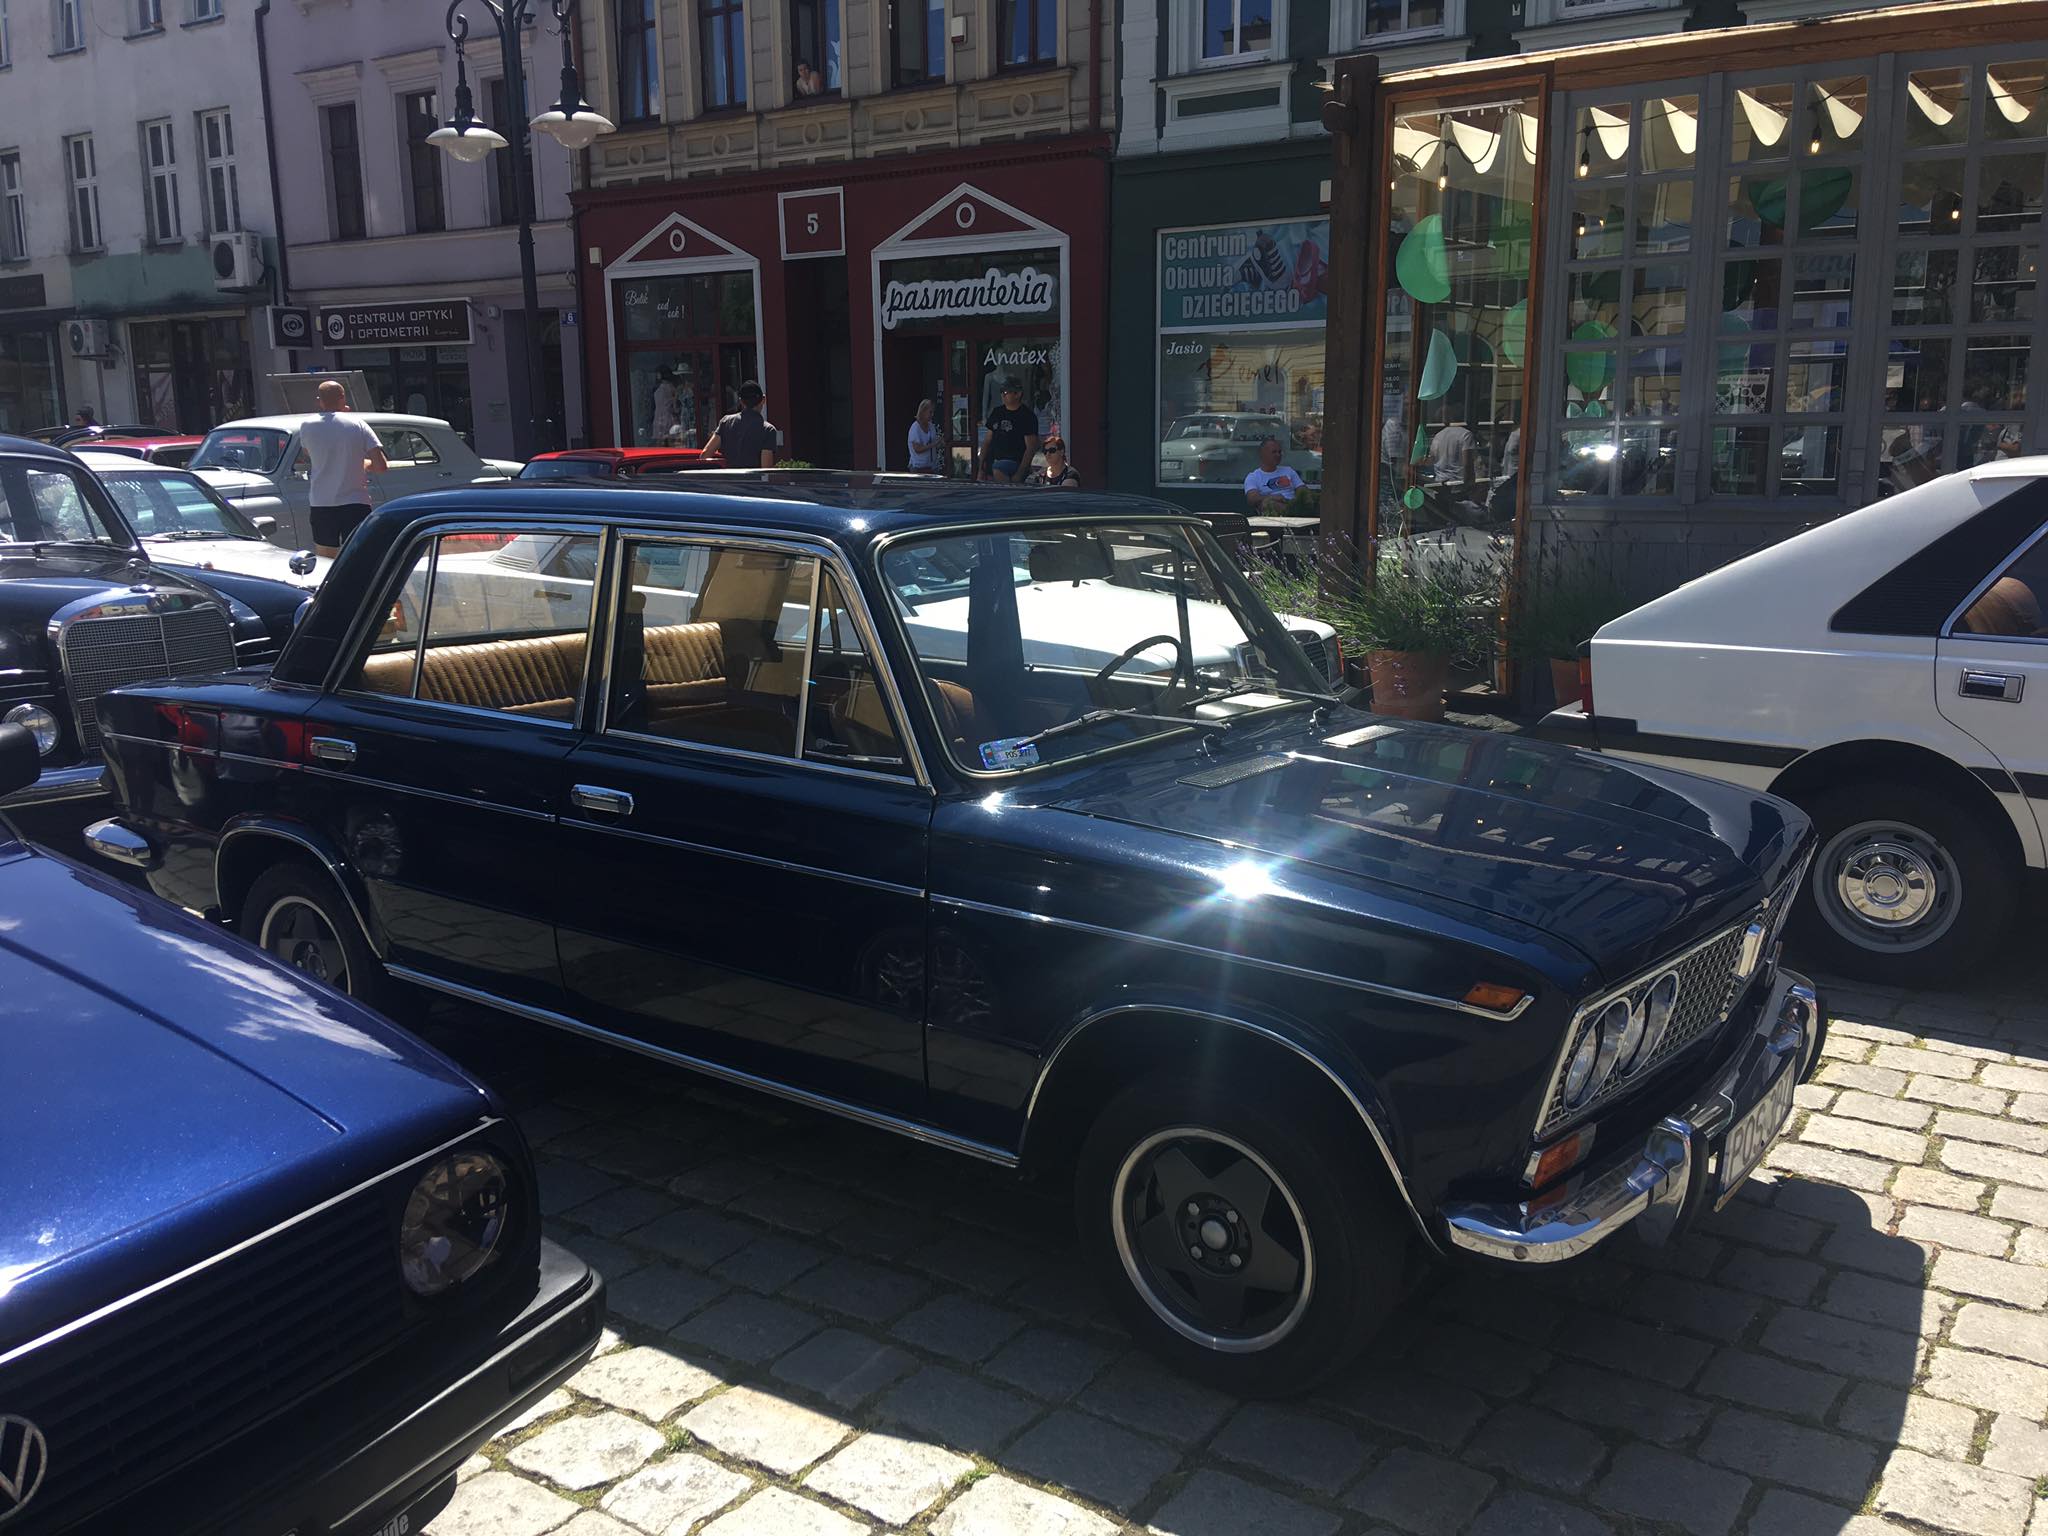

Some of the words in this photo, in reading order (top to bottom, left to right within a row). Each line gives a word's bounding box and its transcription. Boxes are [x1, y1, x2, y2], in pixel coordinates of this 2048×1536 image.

[807, 212, 819, 235] 5
[1165, 233, 1248, 261] Centrum
[1165, 264, 1233, 290] Obuwia
[887, 275, 1048, 323] pasmanteria
[1182, 288, 1300, 319] DZIECIĘCEGO
[349, 310, 405, 324] CENTRUM
[410, 309, 452, 321] OPTYKI
[567, 312, 574, 322] 6
[358, 327, 429, 339] OPTOMETRII
[983, 347, 1047, 366] Anatex
[1166, 341, 1204, 355] Jasio
[1728, 1103, 1766, 1182] POS
